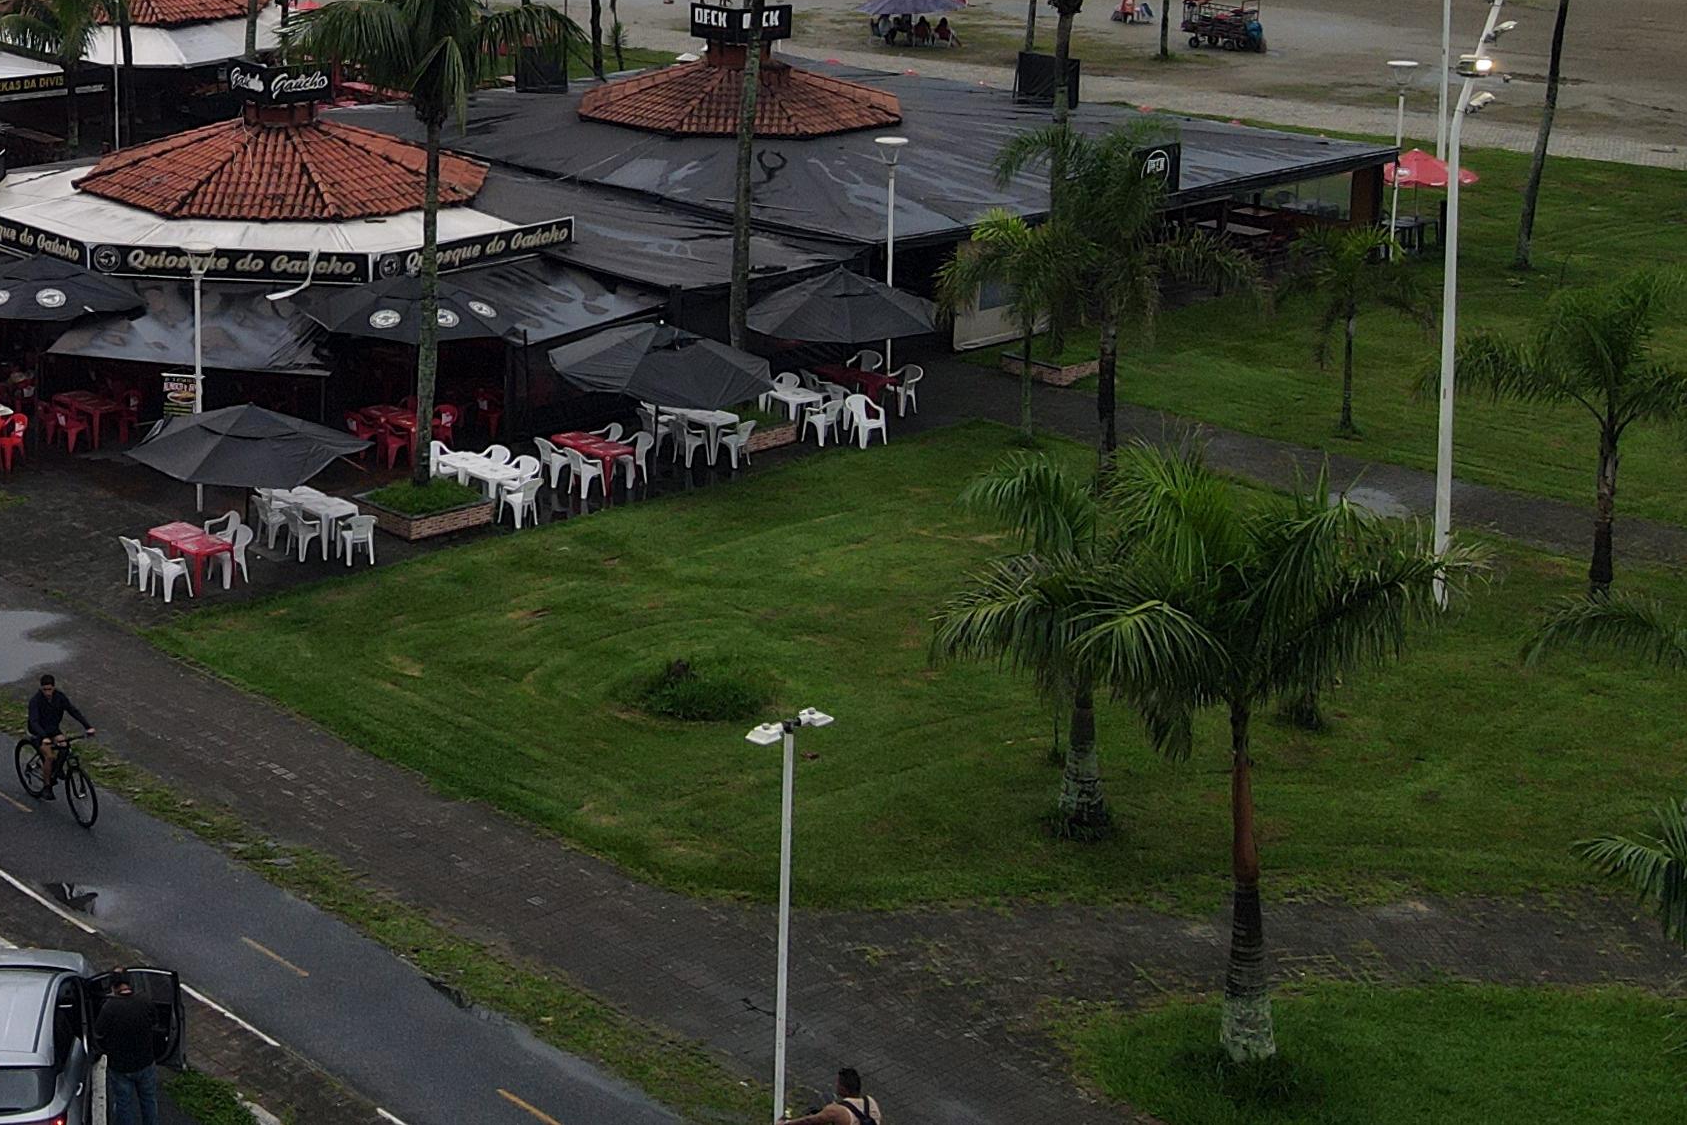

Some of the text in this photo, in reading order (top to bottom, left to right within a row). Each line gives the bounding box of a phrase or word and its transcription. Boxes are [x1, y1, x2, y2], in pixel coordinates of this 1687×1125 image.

[694, 7, 727, 28] DECK
[742, 9, 780, 30] DCK
[24, 78, 37, 90] DA
[271, 70, 328, 100] Gaúcho
[19, 227, 34, 247] do
[37, 233, 80, 262] Gaúcho
[405, 224, 569, 272] Quosque do Gaúcho
[235, 252, 264, 272] do
